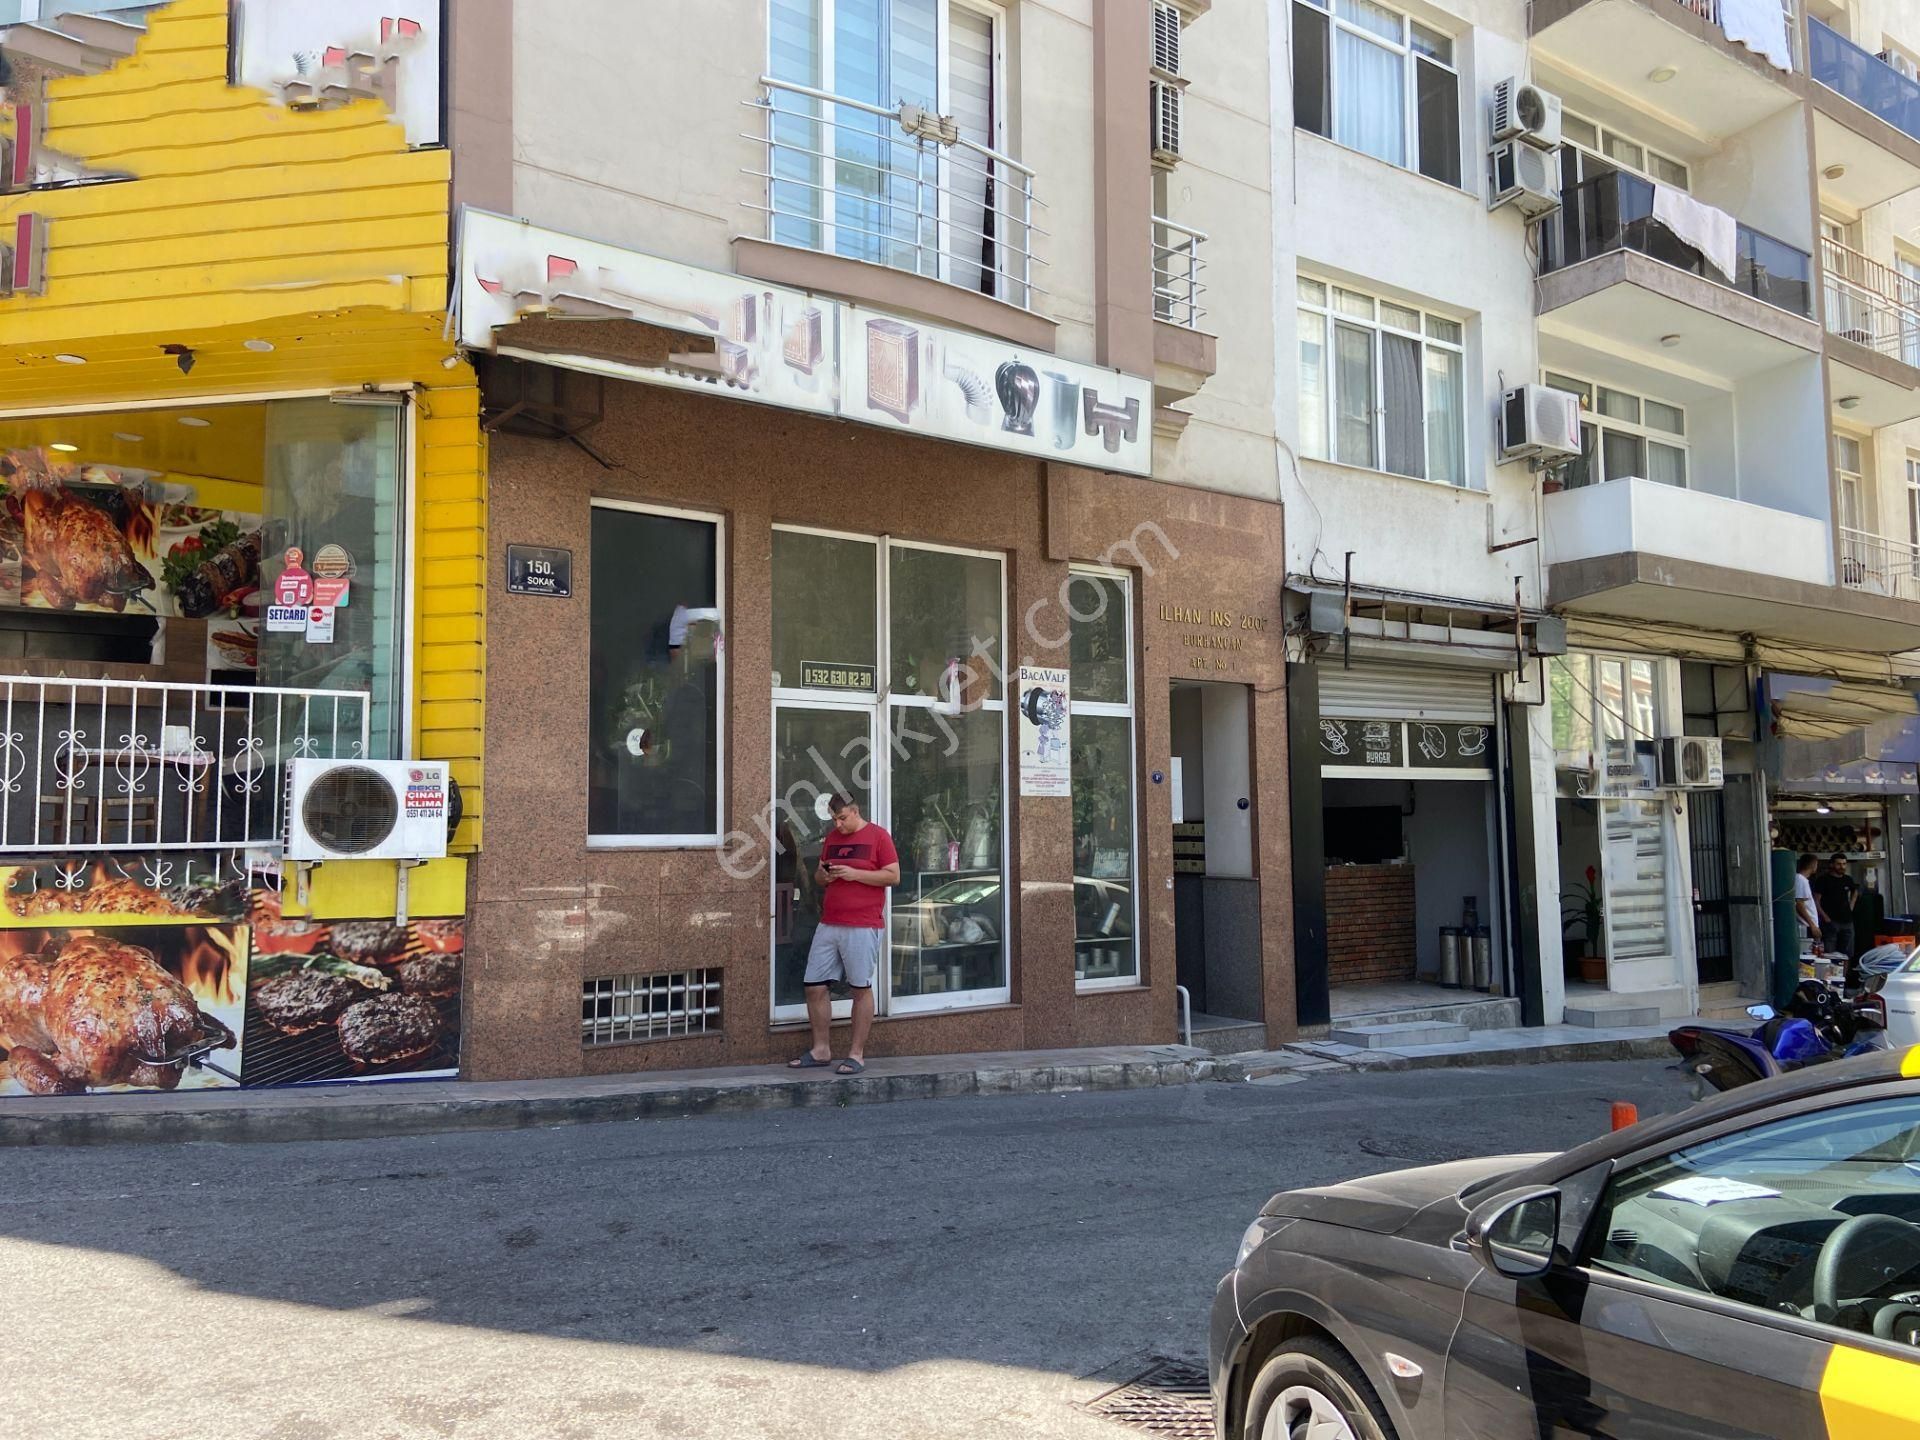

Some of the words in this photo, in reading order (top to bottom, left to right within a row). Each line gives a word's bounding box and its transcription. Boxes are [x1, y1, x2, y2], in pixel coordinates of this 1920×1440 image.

[527, 559, 555, 575] 150.
[527, 576, 556, 588] SOKAK
[268, 608, 306, 621] SETCARD
[812, 669, 829, 684] 532
[830, 670, 847, 685] 630
[848, 672, 859, 686] 82
[860, 672, 871, 686] 30
[426, 772, 440, 780] LG
[408, 791, 442, 801] ÇINAR
